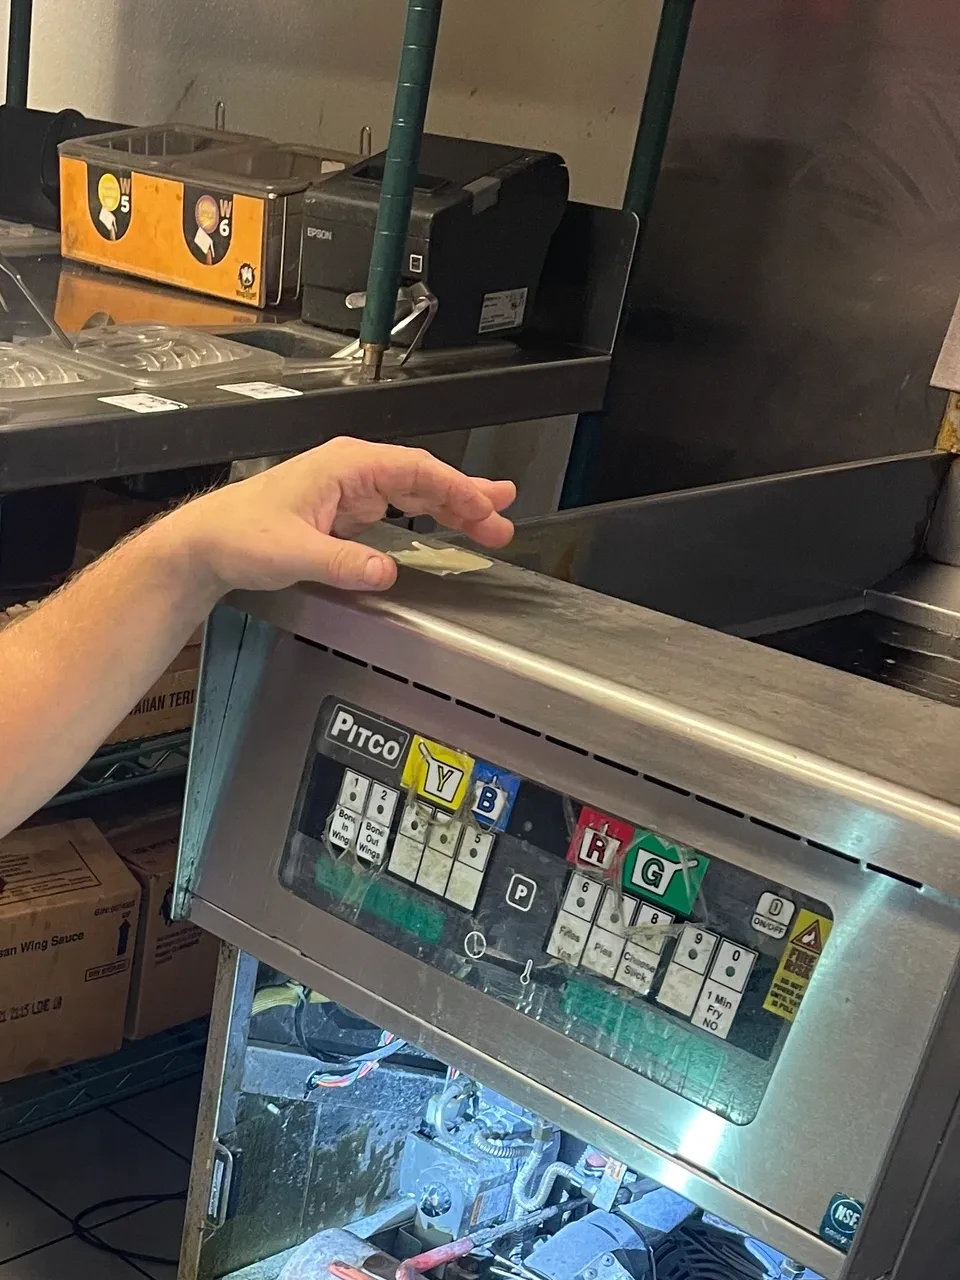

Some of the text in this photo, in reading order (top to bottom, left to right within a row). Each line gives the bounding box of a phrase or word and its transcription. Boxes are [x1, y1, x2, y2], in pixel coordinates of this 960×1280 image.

[119, 178, 131, 194] W
[120, 195, 130, 213] 5
[219, 199, 232, 218] W
[219, 219, 230, 237] 6
[307, 227, 332, 240] EPSON
[169, 689, 196, 707] TERI
[437, 765, 455, 793] Y
[380, 789, 388, 801] 2
[476, 786, 499, 814] B
[341, 822, 349, 832] In
[366, 834, 379, 847] Out
[474, 833, 482, 844] 5
[359, 842, 381, 860] Wings
[586, 832, 606, 865] R
[641, 857, 665, 890] G
[514, 884, 528, 900] P
[581, 881, 590, 893] 6
[650, 912, 659, 925] 8
[753, 917, 785, 935] ON/OFF
[19, 939, 48, 952] Wing
[50, 931, 85, 947] Sauce
[694, 932, 703, 945] 9
[731, 949, 741, 962] 0
[707, 991, 732, 1010] 1 Min
[706, 1004, 723, 1020] Fry
[702, 1017, 719, 1031] NO
[834, 1204, 860, 1226] NSF
